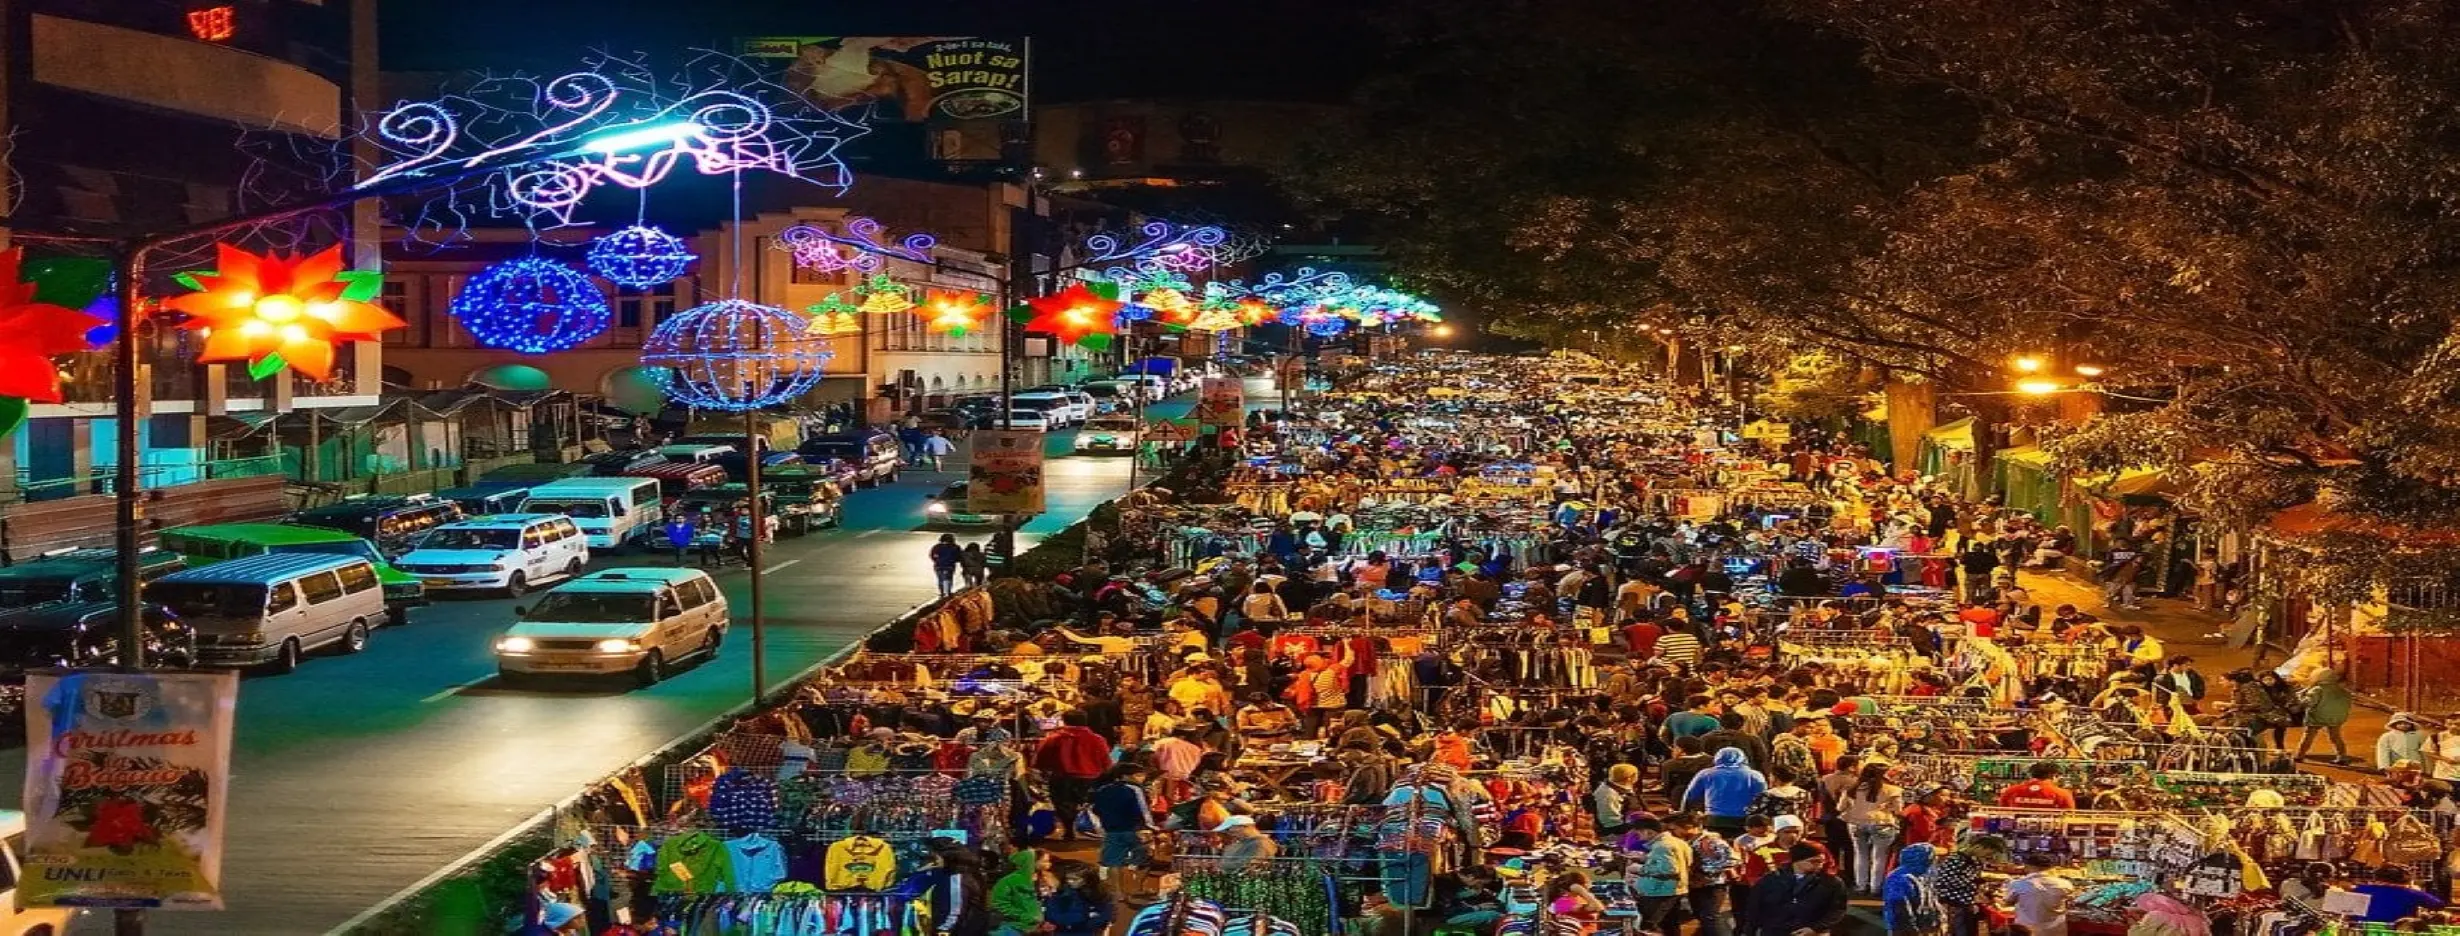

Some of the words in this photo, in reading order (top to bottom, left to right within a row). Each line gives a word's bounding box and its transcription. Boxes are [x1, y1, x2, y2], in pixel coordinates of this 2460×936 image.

[926, 52, 984, 69] Nuot
[988, 55, 1020, 69] sa
[926, 70, 1021, 88] Sarap!
[44, 867, 106, 882] UNLI
